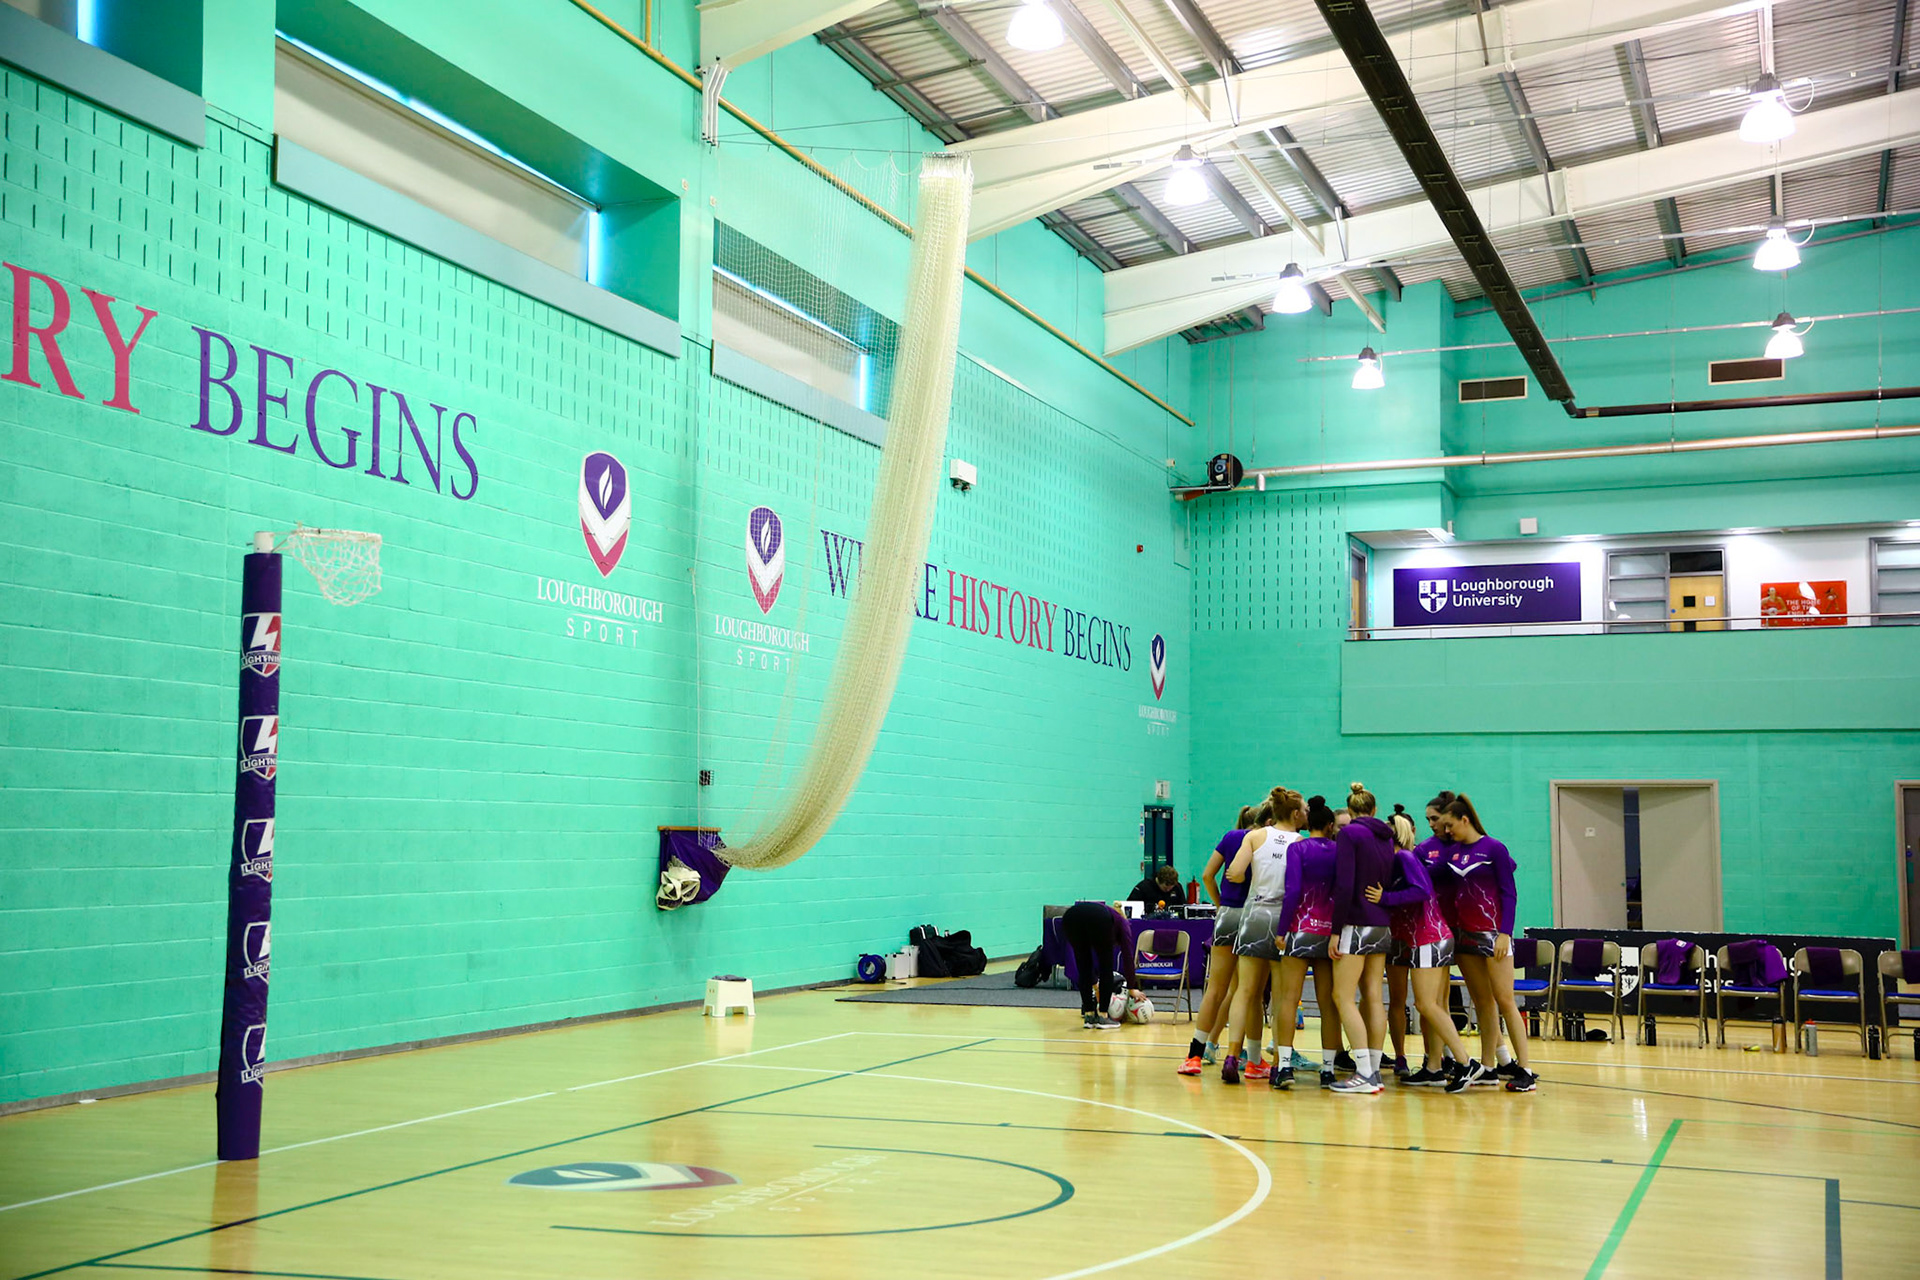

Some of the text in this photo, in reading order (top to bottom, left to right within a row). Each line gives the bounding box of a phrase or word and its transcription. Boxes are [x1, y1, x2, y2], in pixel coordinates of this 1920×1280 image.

[191, 326, 479, 500] BEGINS
[537, 577, 663, 623] LOUGHBOROUGH
[1452, 576, 1555, 593] Loughborough
[1452, 593, 1523, 608] University
[566, 618, 639, 647] SPORT
[715, 615, 809, 652] LOUGHBOROUGH
[946, 569, 1058, 653] HISTORY
[1063, 607, 1132, 672] BEGINS
[736, 649, 791, 674] SPORT
